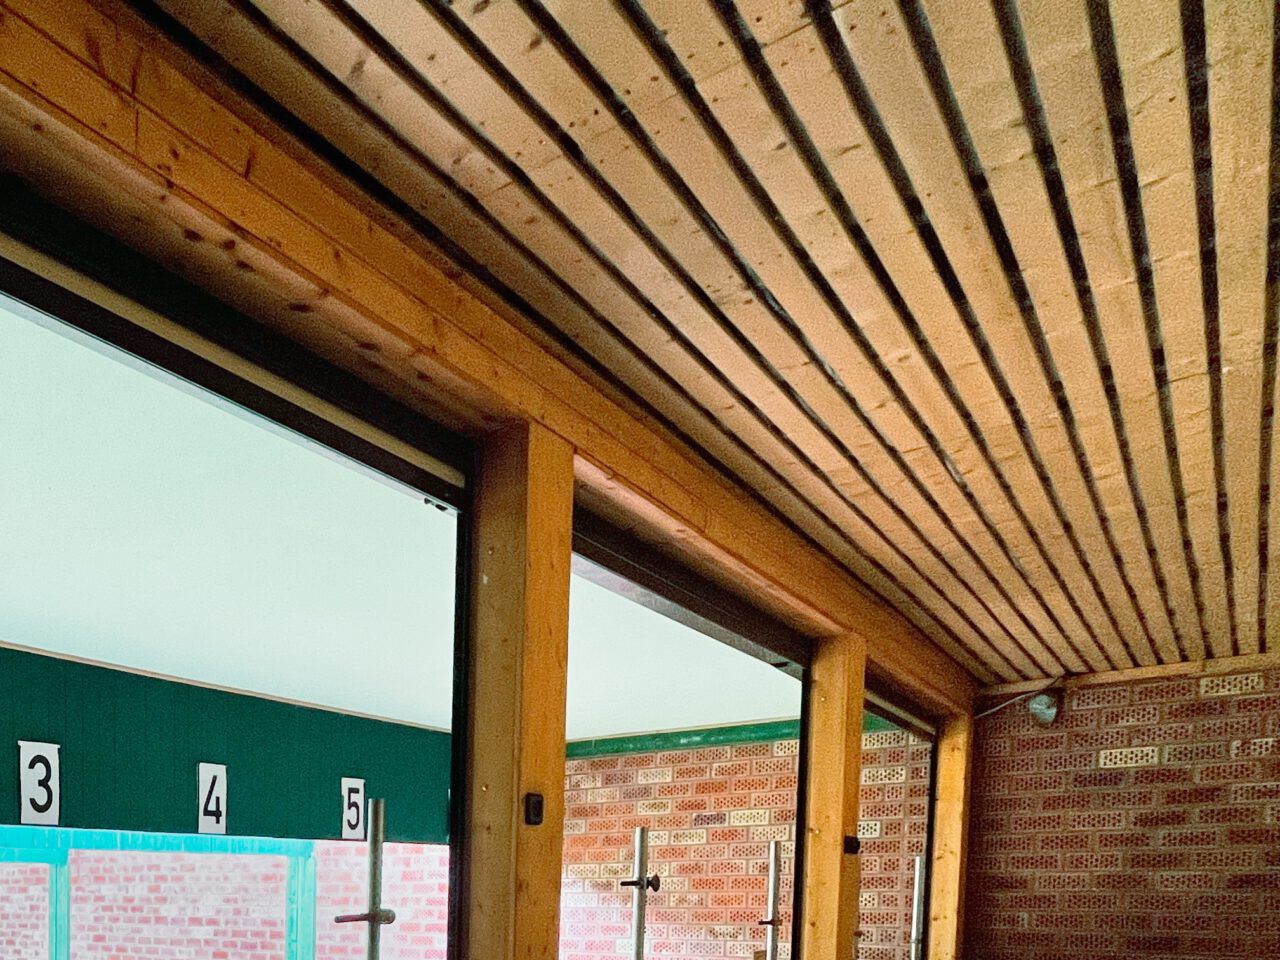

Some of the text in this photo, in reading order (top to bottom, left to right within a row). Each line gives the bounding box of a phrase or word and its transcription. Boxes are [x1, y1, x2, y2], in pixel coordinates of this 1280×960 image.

[27, 754, 53, 813] 3
[202, 775, 222, 824] 4
[346, 787, 360, 831] 5
